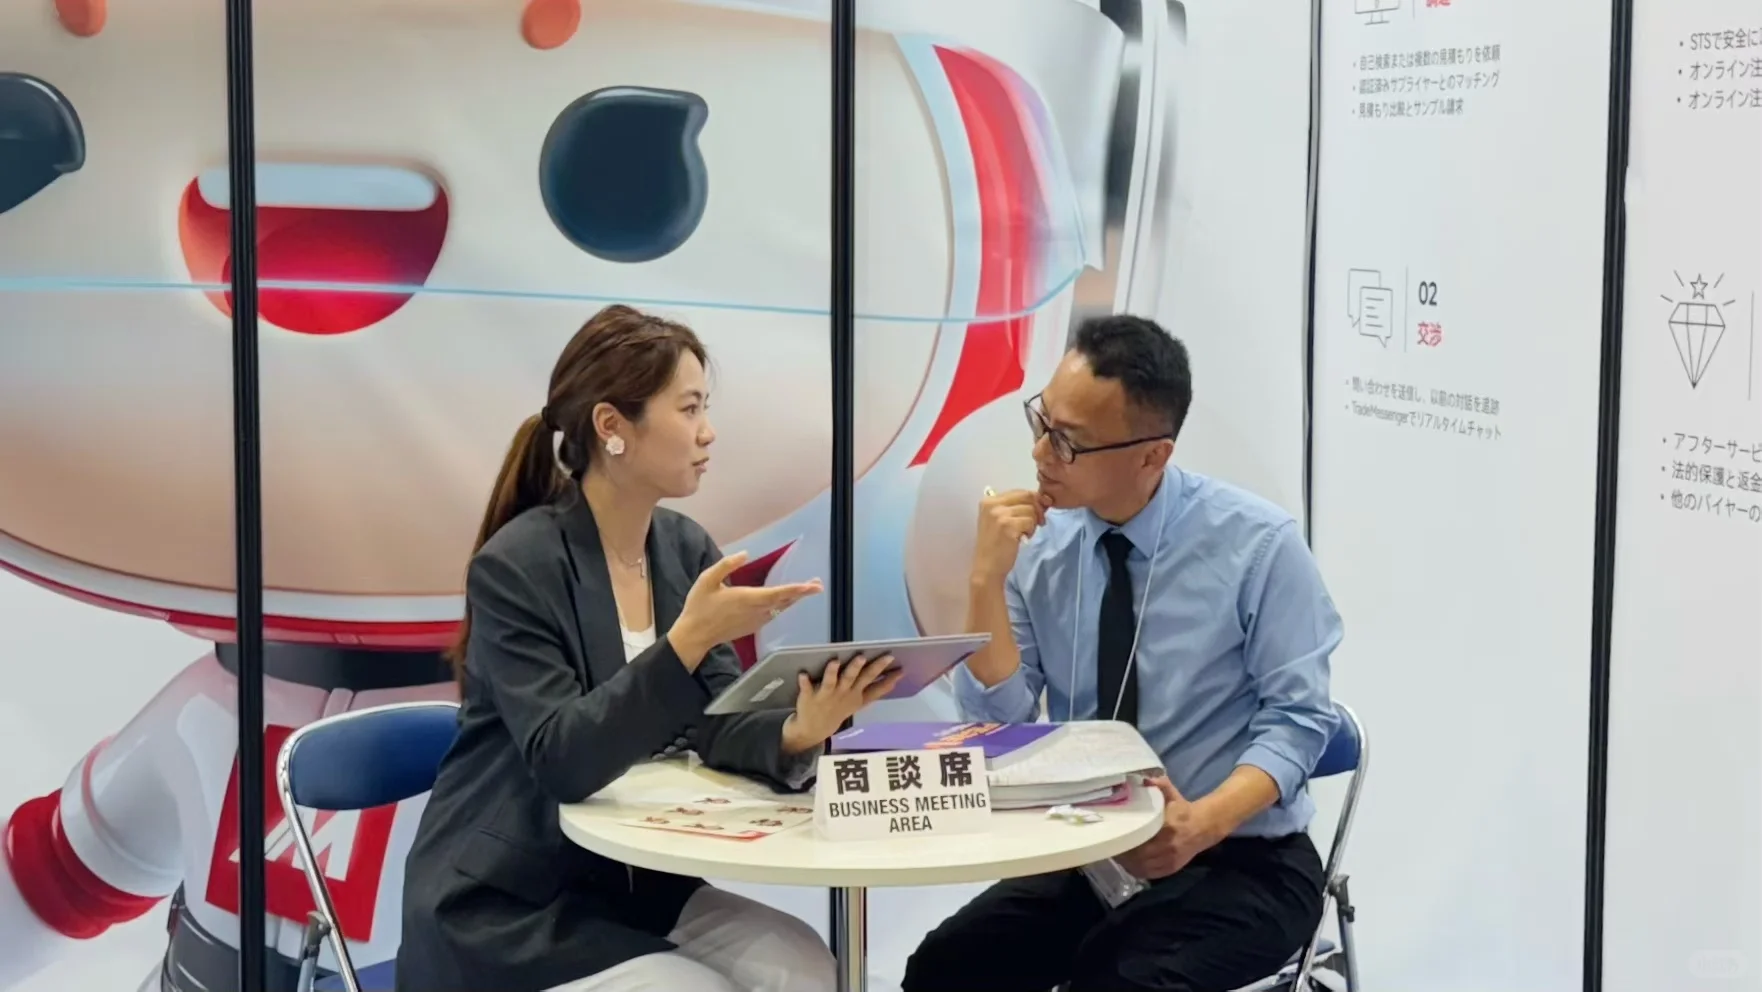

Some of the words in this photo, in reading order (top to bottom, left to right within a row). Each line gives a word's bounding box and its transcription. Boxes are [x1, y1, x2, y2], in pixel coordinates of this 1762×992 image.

[1690, 27, 1762, 51] STSで安全に
[1418, 281, 1438, 306] 02
[1416, 321, 1443, 347] 交渉
[834, 751, 972, 796] 商談席
[829, 797, 910, 819] BUSINESS
[914, 792, 987, 813] MEETING
[888, 815, 933, 834] AREA
